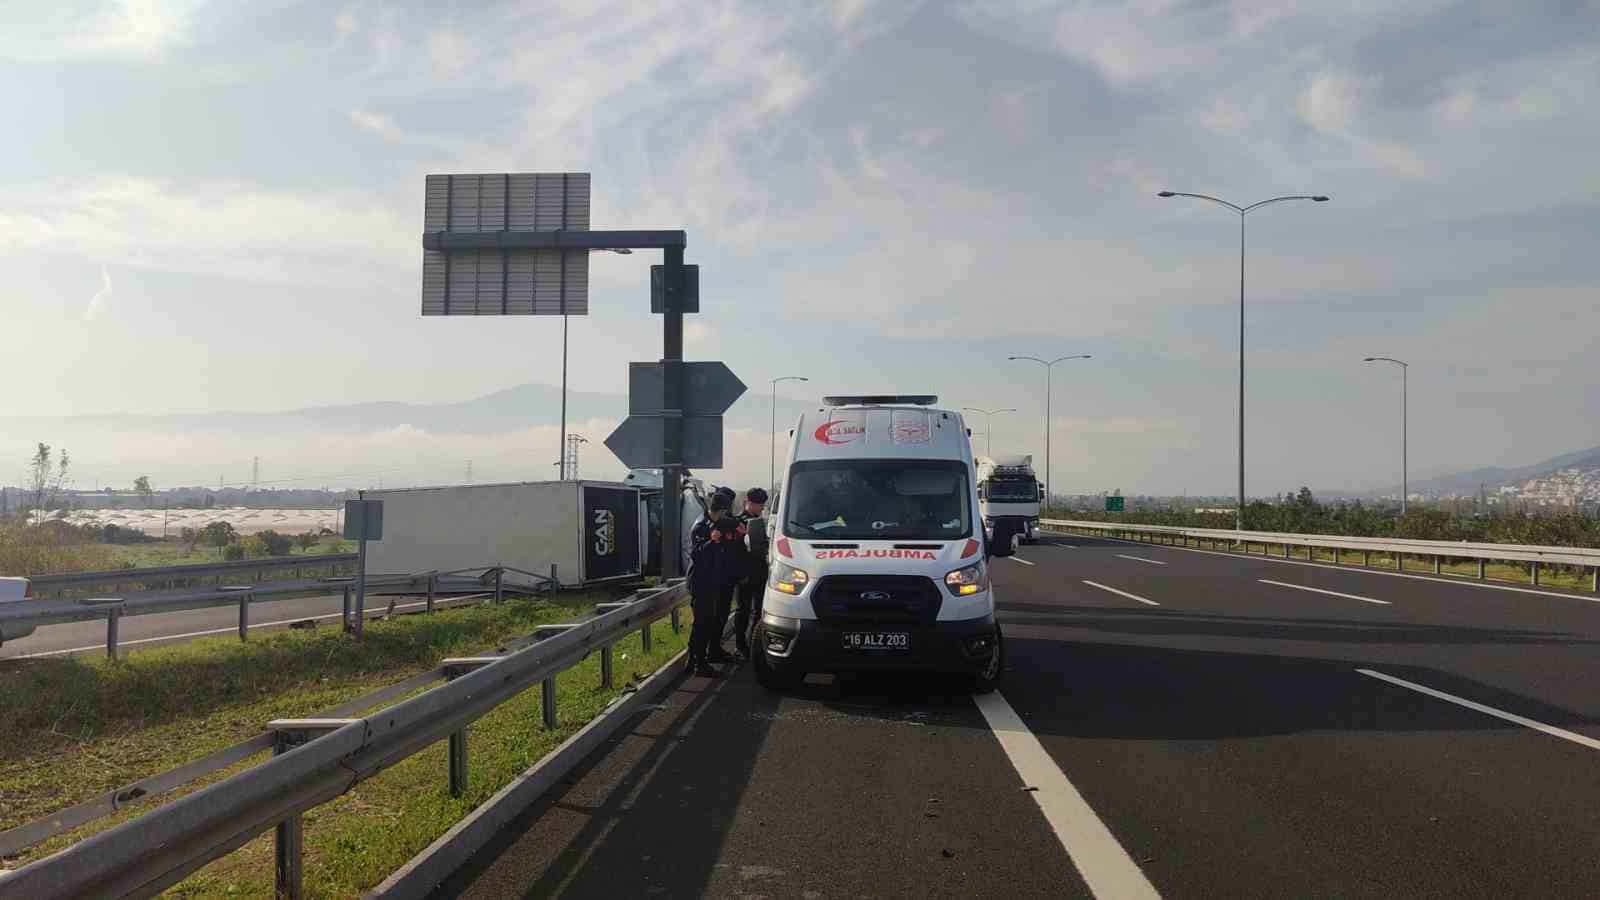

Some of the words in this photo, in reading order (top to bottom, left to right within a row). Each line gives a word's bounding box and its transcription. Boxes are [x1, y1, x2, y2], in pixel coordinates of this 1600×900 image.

[850, 634, 861, 646] 16
[864, 634, 885, 646] ALZ
[887, 634, 906, 646] 203
